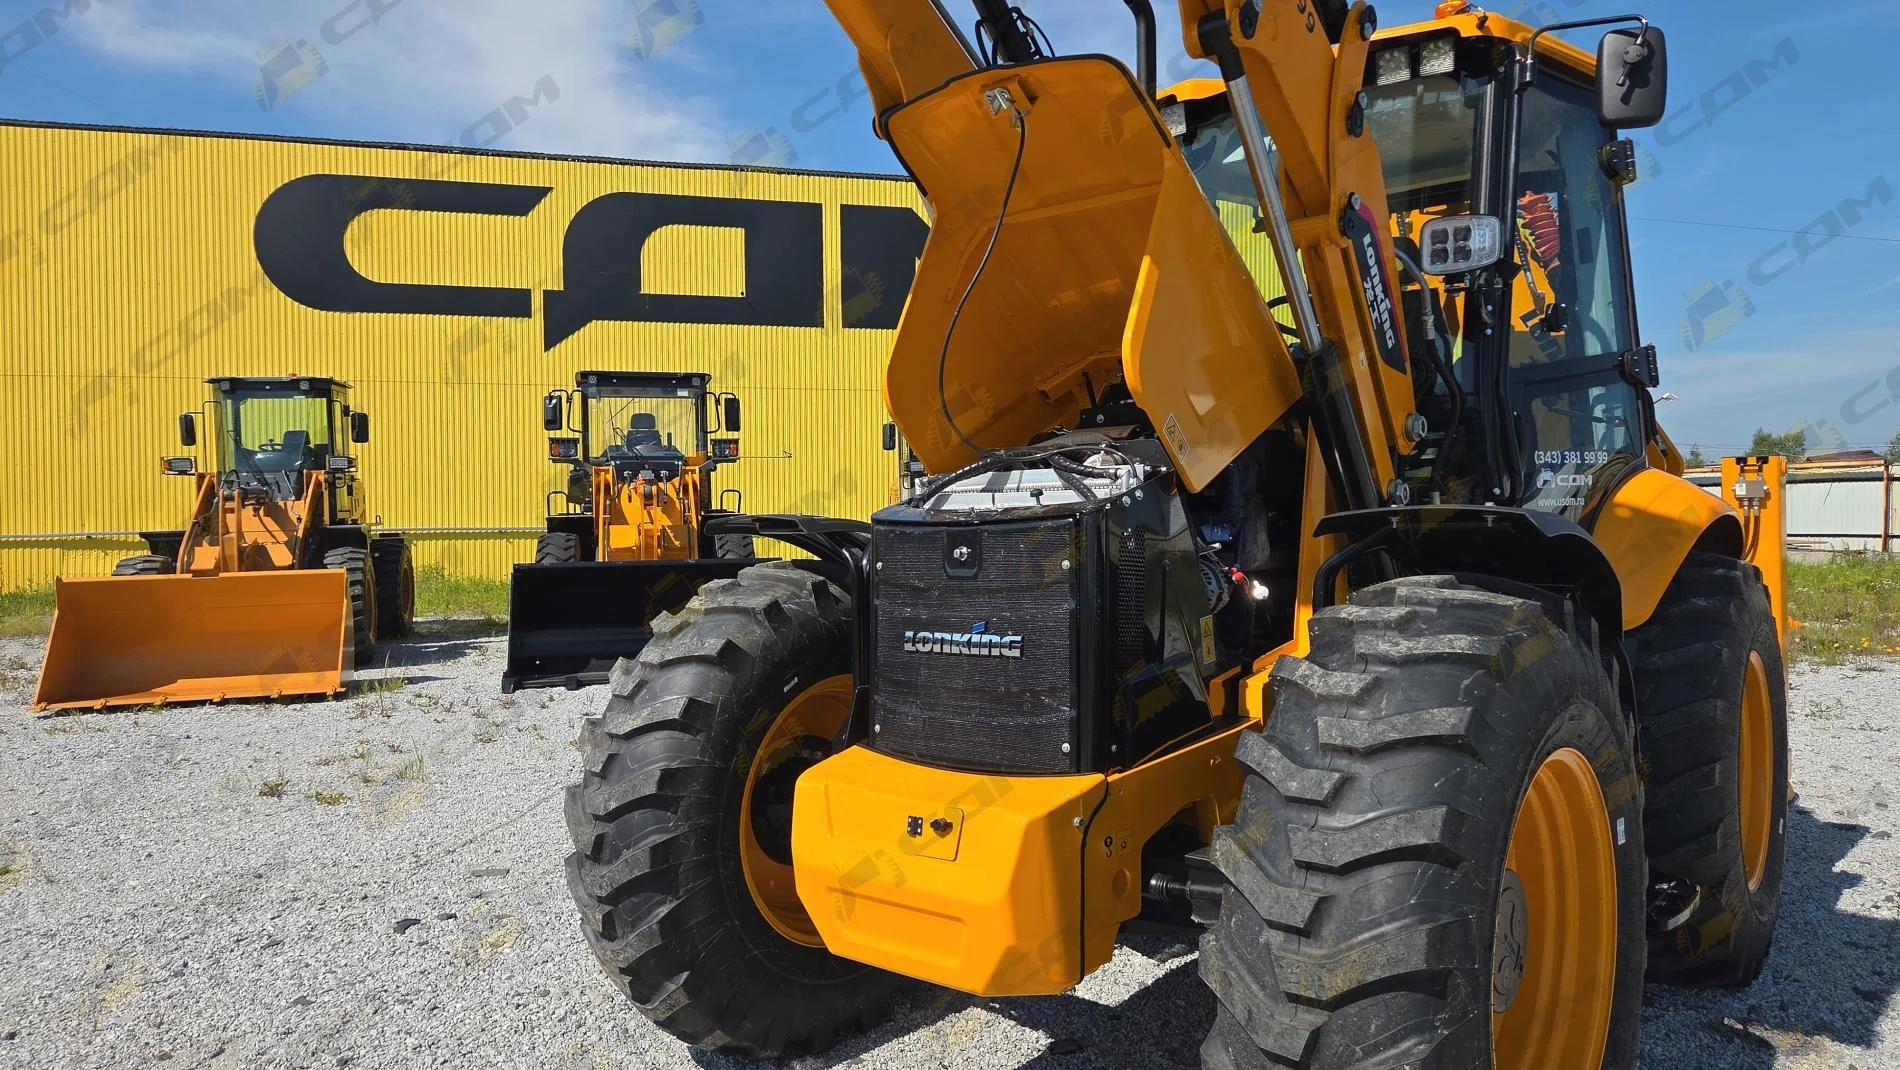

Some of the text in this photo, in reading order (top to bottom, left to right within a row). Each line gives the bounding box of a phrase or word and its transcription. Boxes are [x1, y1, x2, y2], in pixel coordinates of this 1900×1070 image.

[1534, 450, 1608, 465] (343) 381 99 99
[1537, 496, 1585, 507] www.usdm.ru
